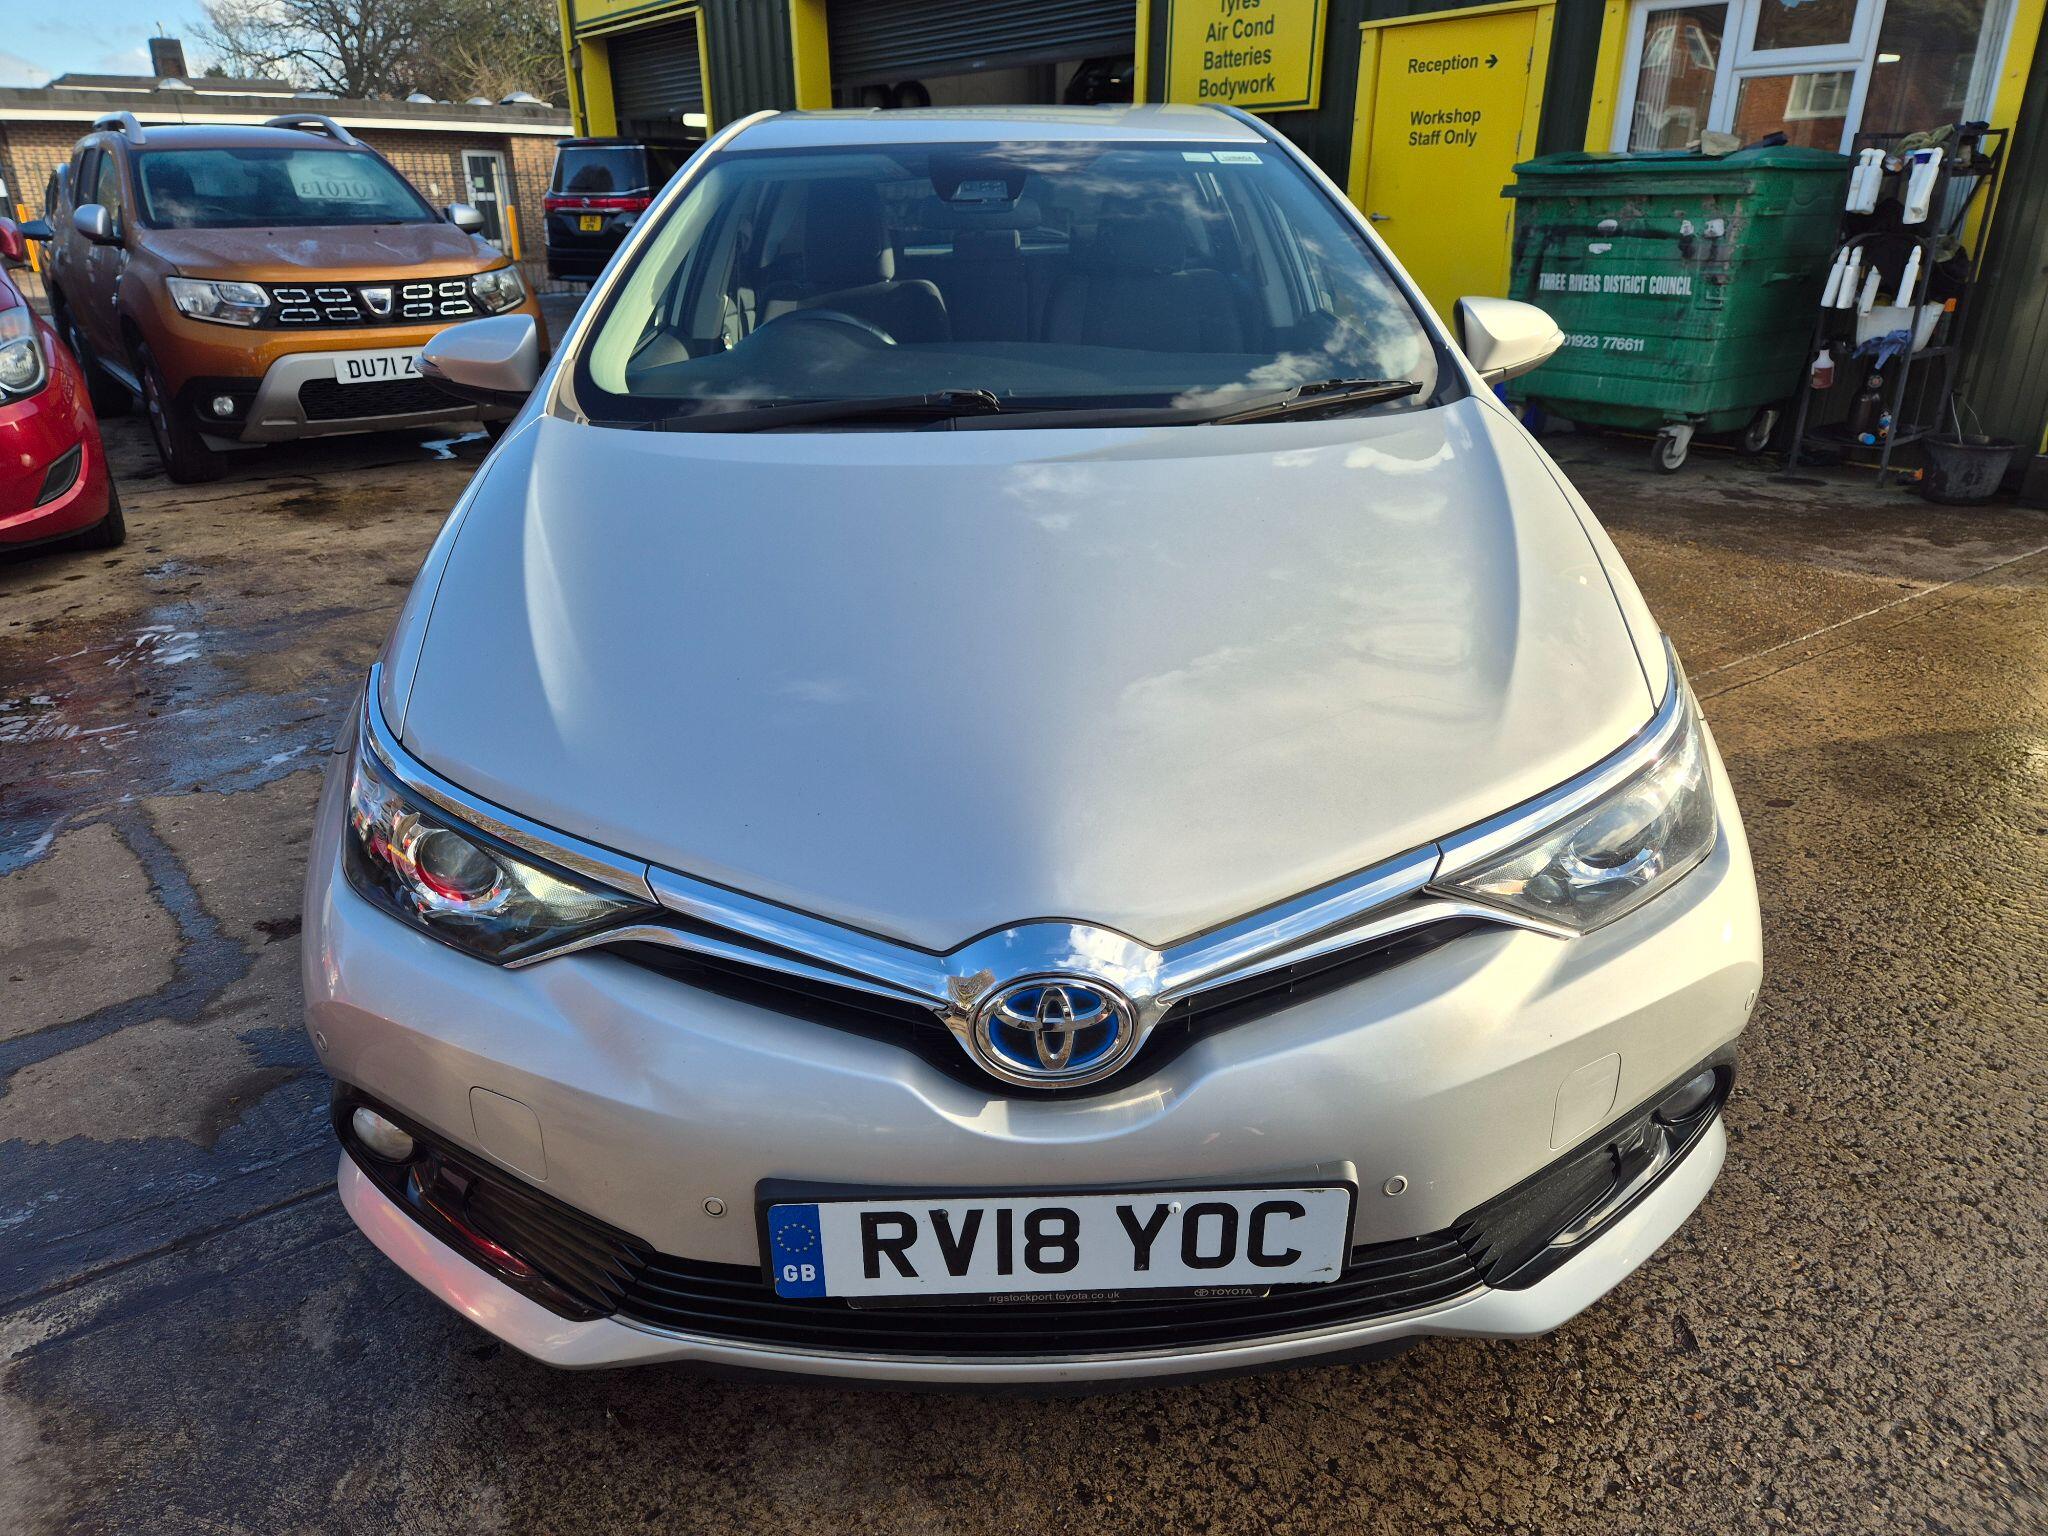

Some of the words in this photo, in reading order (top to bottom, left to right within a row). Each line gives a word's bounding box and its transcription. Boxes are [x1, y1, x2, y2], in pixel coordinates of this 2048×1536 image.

[1205, 22, 1228, 42] Air
[1232, 14, 1274, 39] Cond
[1204, 46, 1272, 70] Batteries
[1408, 54, 1479, 74] Reception
[1199, 73, 1275, 100] Bodywork
[1410, 108, 1481, 126] Workshop
[1408, 130, 1442, 146] Staff
[1444, 129, 1477, 147] Only
[1539, 273, 1566, 290] THREE
[1568, 273, 1601, 292] RIVERS
[1603, 275, 1647, 294] DISTRICT
[1649, 276, 1692, 295] COUNCIL
[1602, 336, 1645, 351] 776611
[347, 357, 397, 378] DU71
[860, 1207, 1080, 1279] RV18
[1116, 1200, 1306, 1272] YOC
[782, 1264, 817, 1283] GB
[1210, 1288, 1253, 1296] TOYOTA
